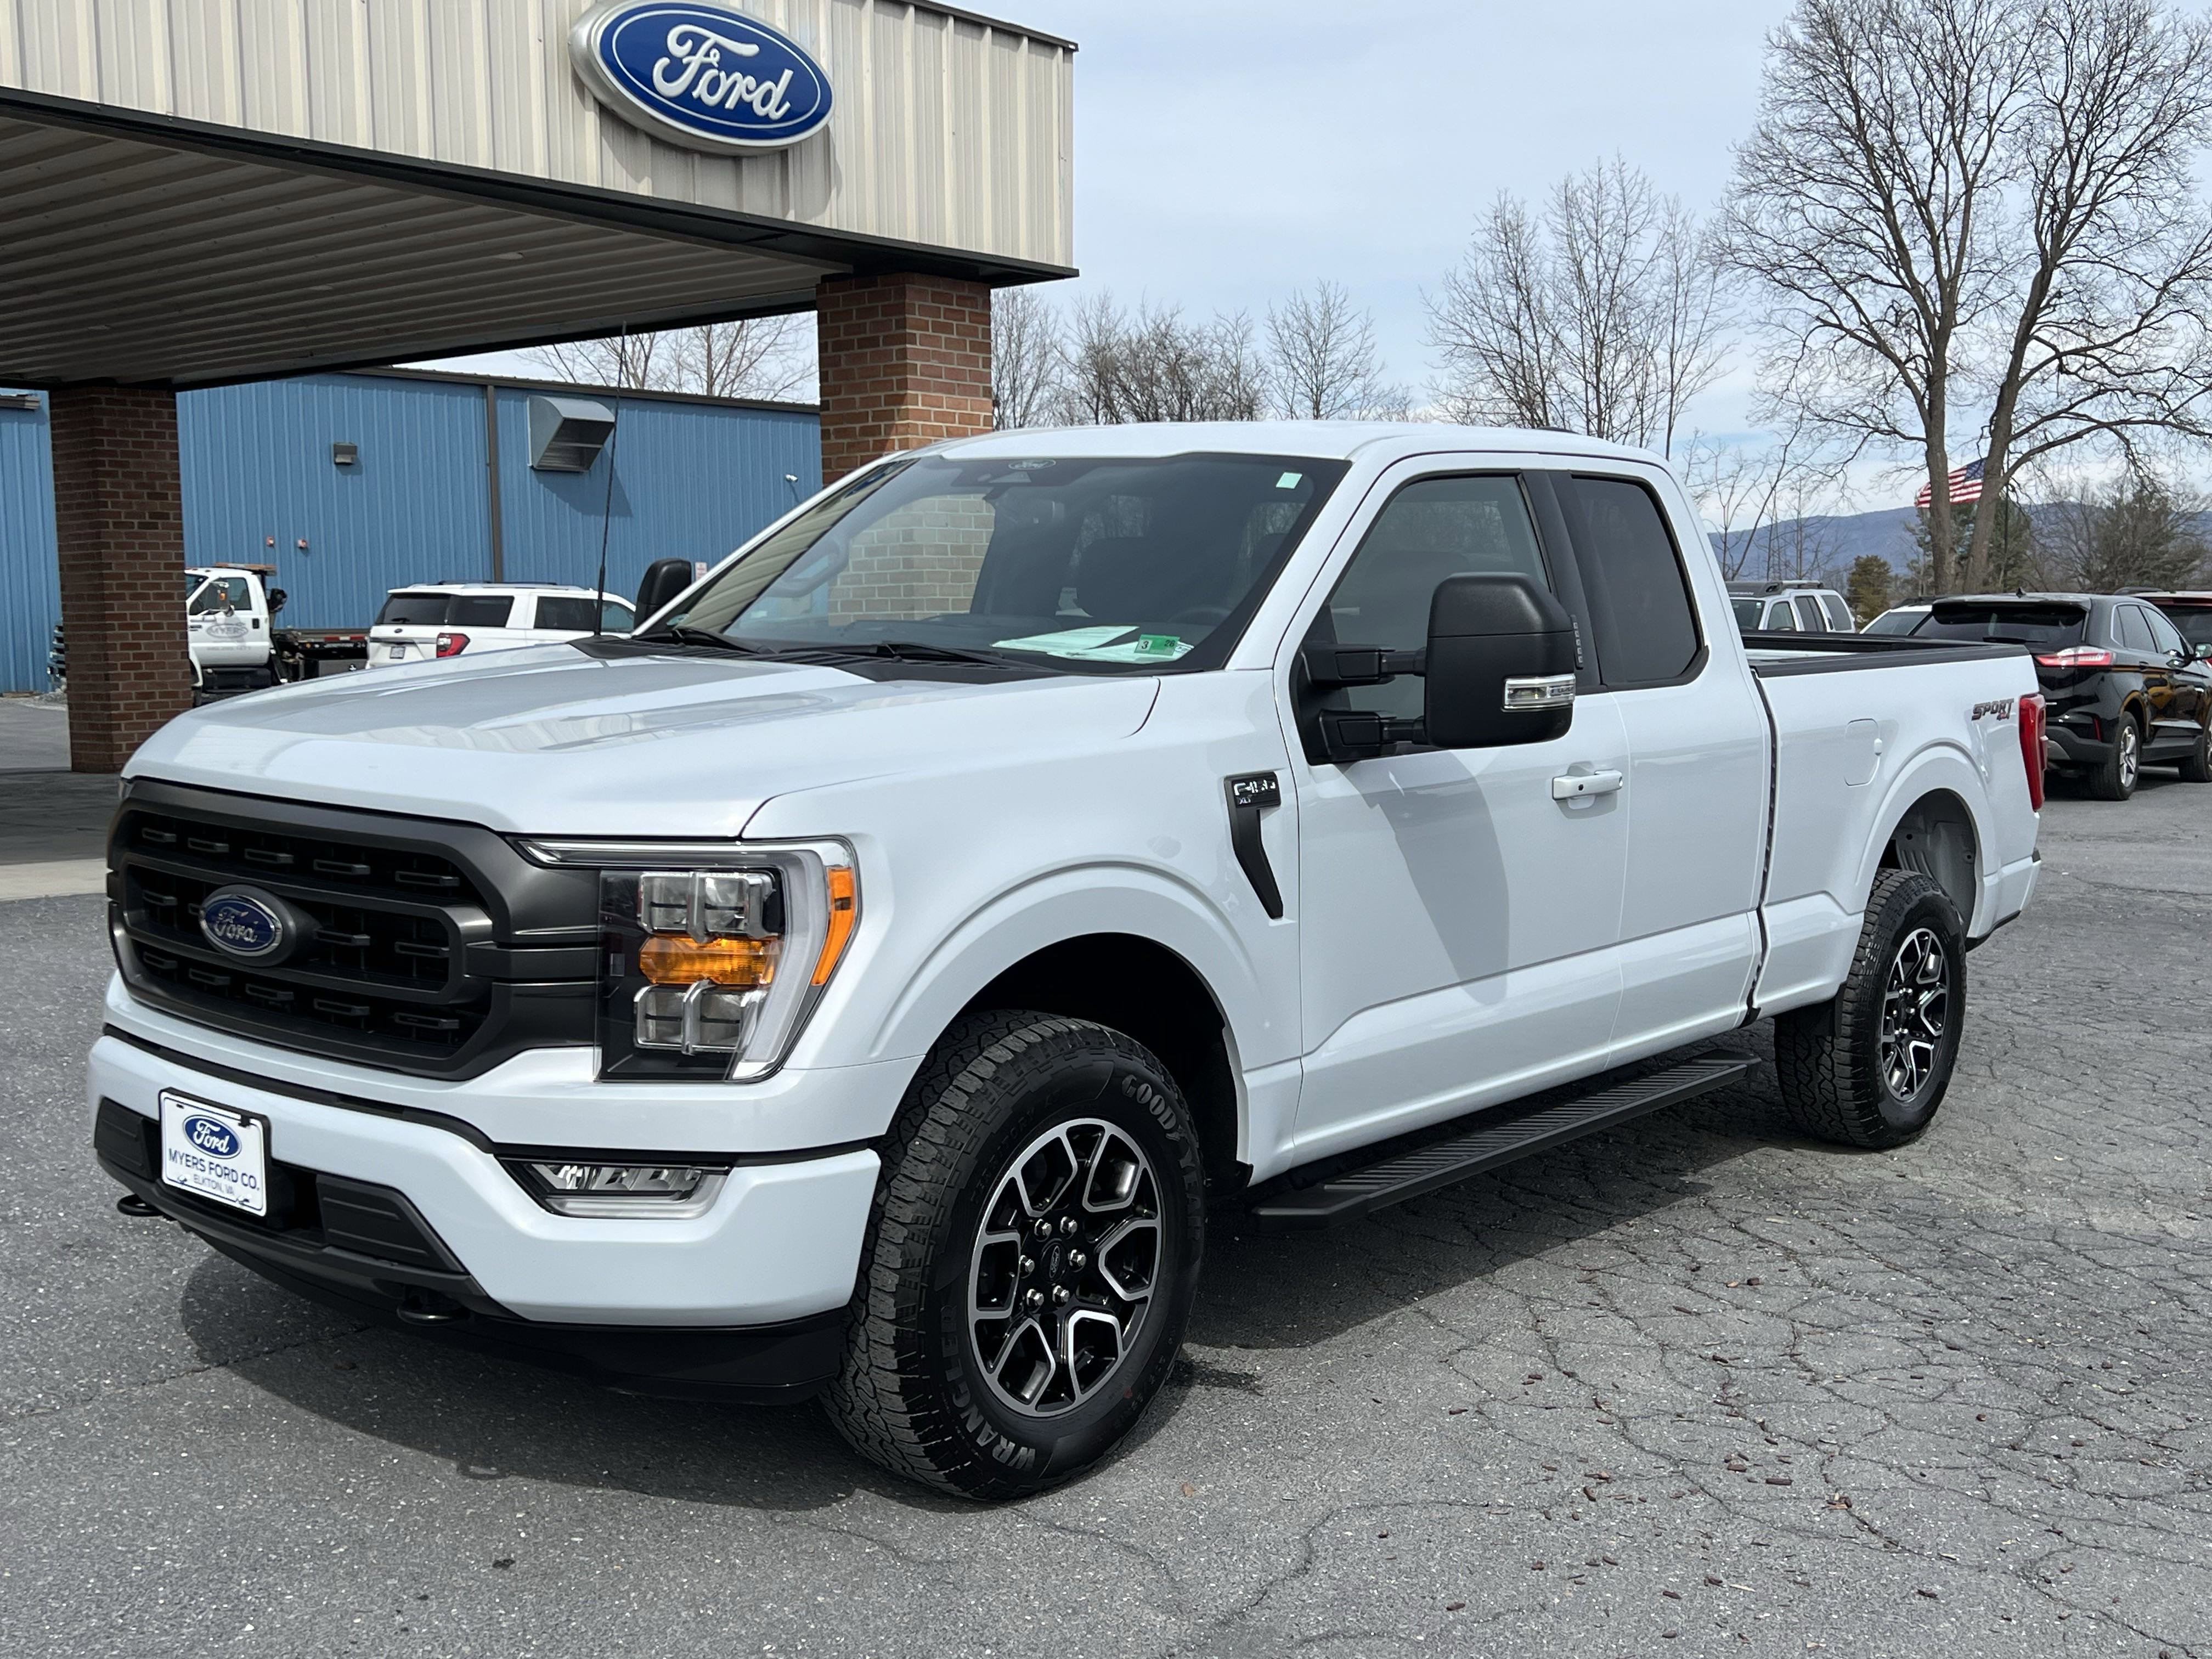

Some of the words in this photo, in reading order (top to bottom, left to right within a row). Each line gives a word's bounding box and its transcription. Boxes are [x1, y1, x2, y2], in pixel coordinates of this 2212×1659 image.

[652, 24, 794, 120] Ford
[1141, 641, 1149, 650] 3
[1971, 698, 2015, 720] SPORT
[213, 906, 258, 943] Ford
[193, 1120, 230, 1154] Ford
[168, 1148, 206, 1172] MYERS
[208, 1161, 239, 1183] FORD
[240, 1172, 259, 1192] CO.
[940, 1304, 1036, 1471] WRANGLER
